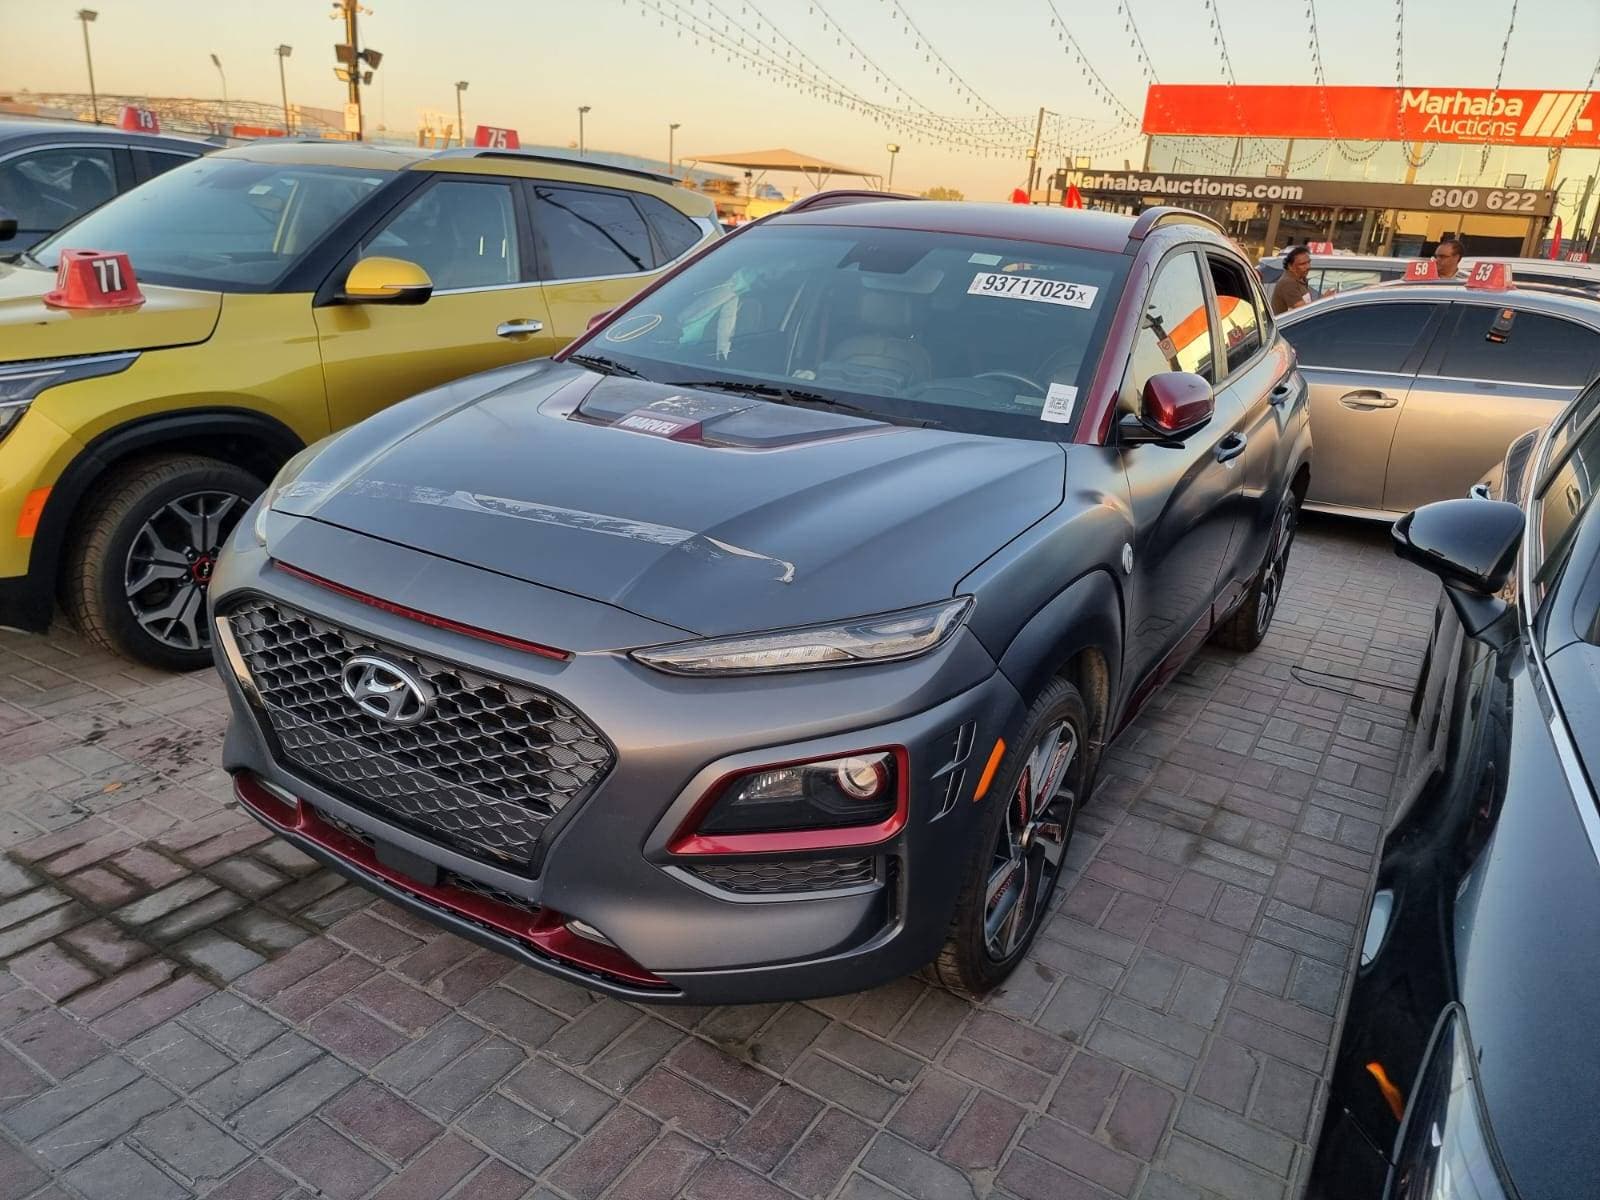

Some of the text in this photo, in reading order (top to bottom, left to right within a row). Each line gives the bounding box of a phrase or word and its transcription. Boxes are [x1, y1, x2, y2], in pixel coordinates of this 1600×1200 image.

[1401, 89, 1523, 117] Marhaba
[1423, 115, 1517, 137] Auctions
[488, 128, 507, 149] 75
[1066, 171, 1304, 201] MarhabaAuctions.com
[1429, 188, 1537, 211] 800 622
[92, 258, 124, 293] 77
[1414, 261, 1429, 275] 58
[1475, 262, 1492, 281] 53
[619, 415, 683, 435] MARVEL
